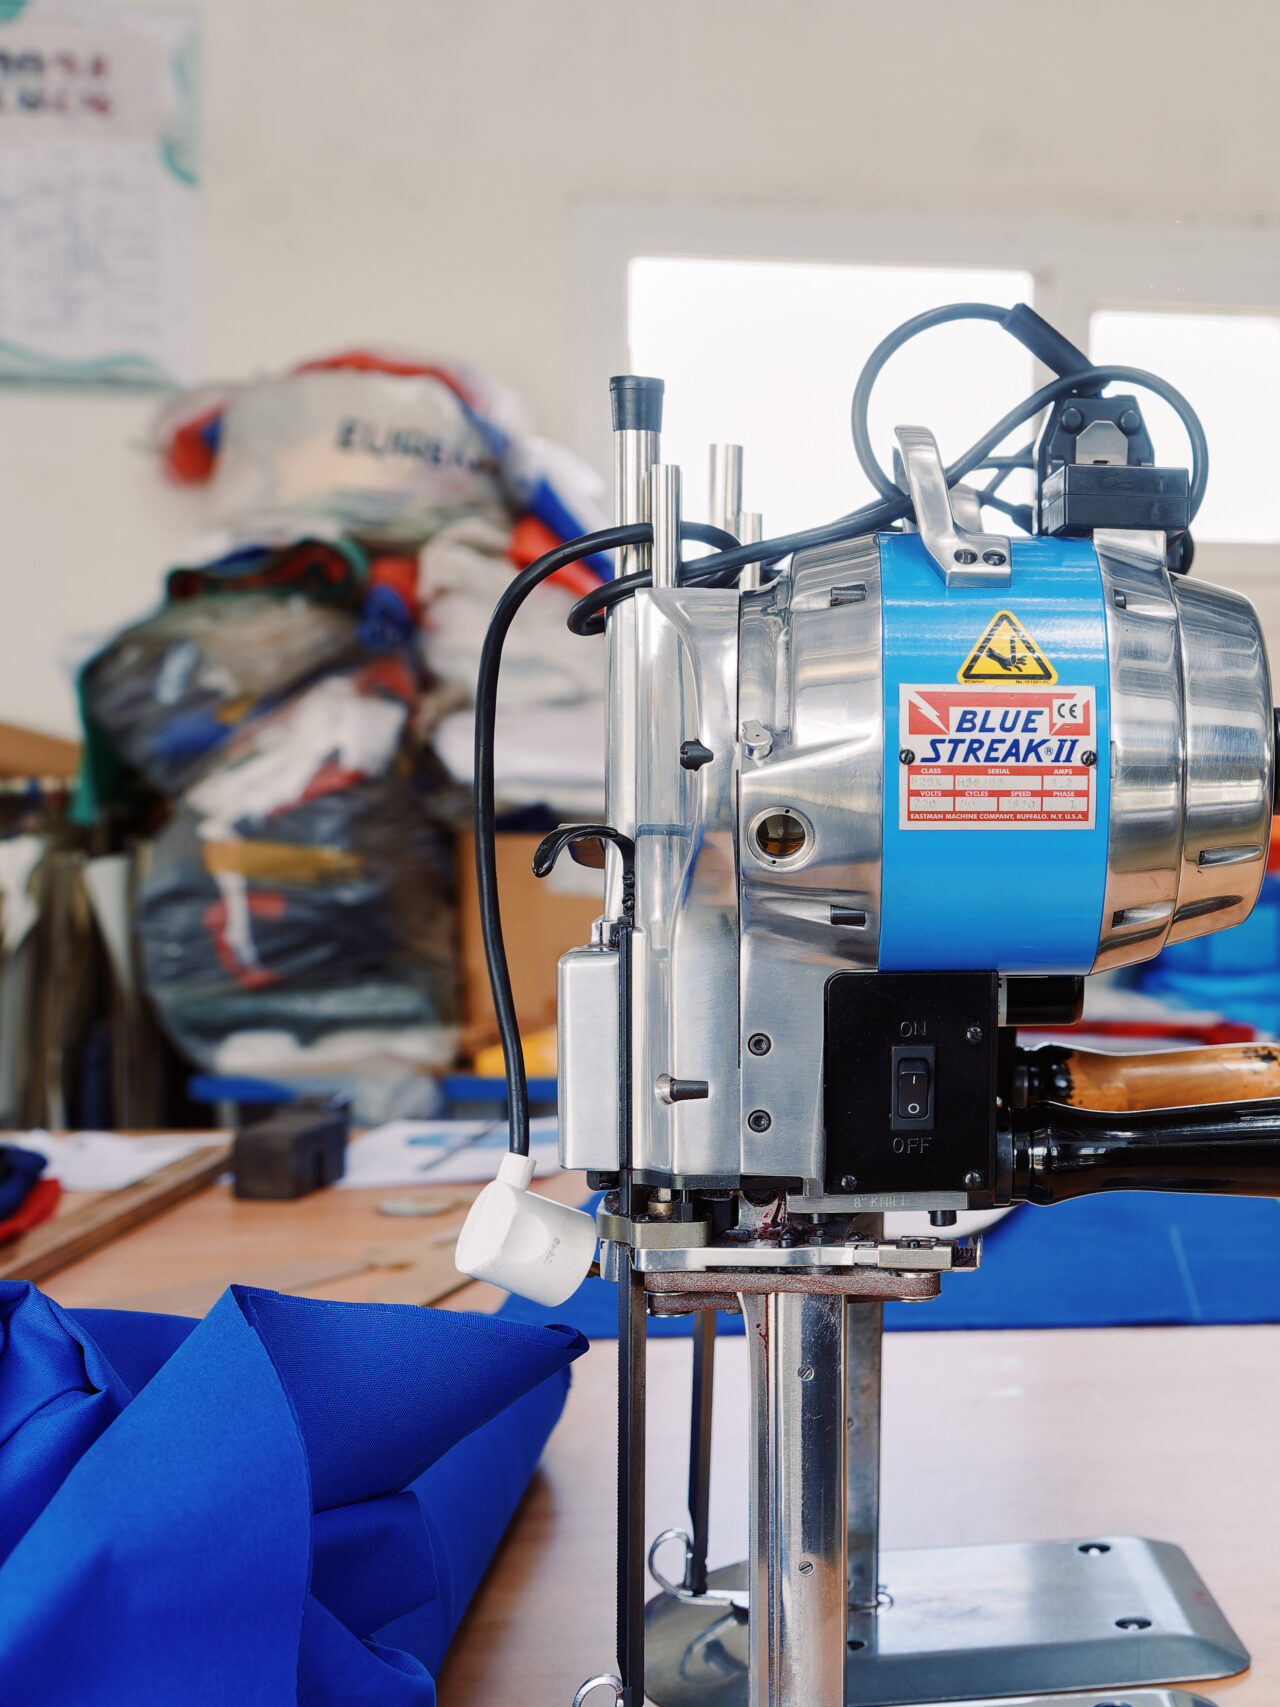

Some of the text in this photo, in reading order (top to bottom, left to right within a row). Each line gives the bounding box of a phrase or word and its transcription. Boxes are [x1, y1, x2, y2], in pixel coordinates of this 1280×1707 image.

[955, 710, 1044, 733] BLUE
[979, 813, 1014, 821] COMPANY,
[899, 1021, 927, 1038] ON
[893, 1137, 932, 1154] OFF
